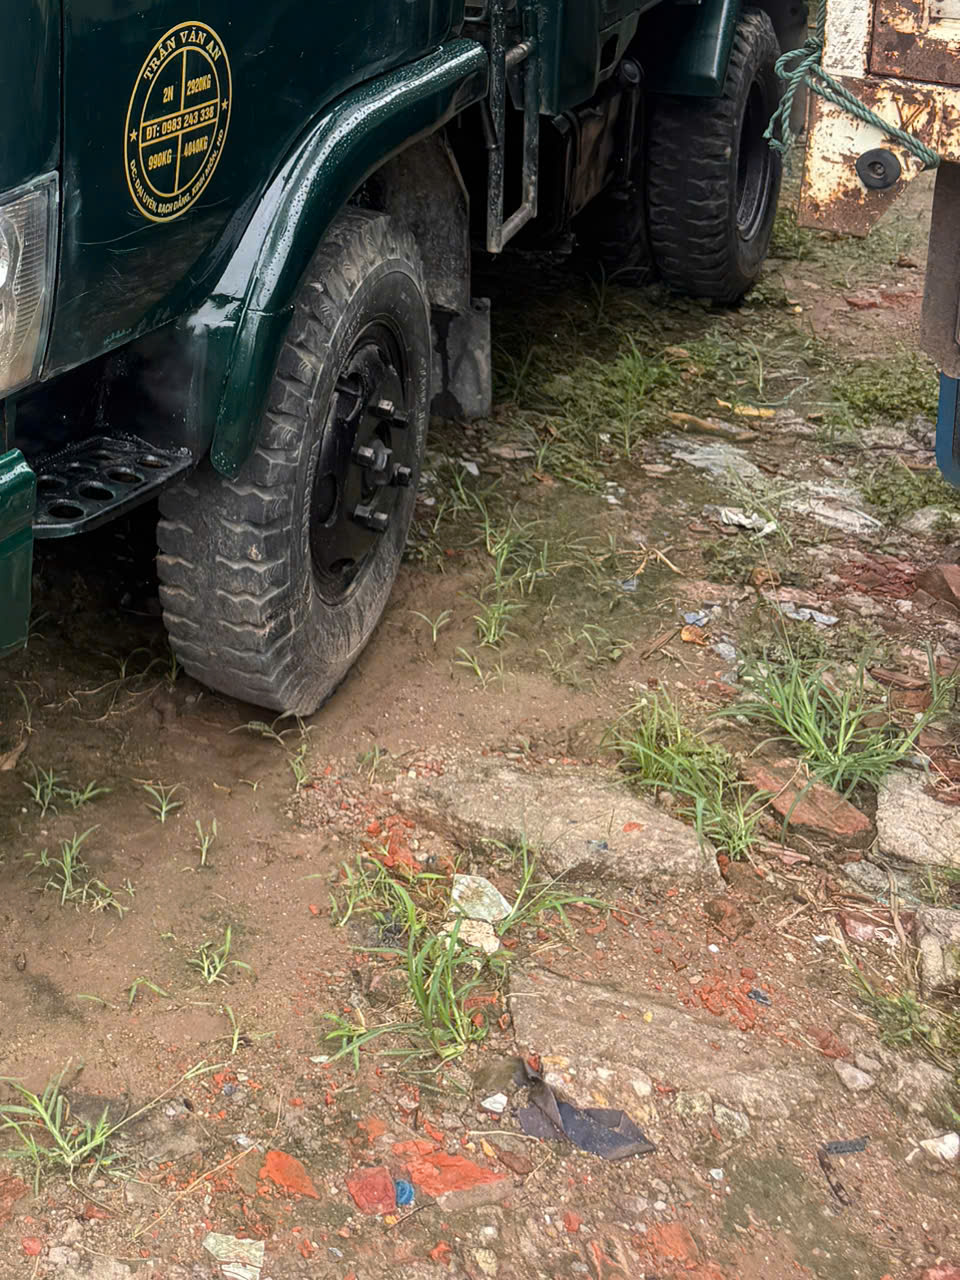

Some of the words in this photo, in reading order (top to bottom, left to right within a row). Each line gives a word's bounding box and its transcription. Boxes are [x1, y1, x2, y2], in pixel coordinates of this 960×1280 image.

[180, 27, 206, 46] VĂN
[206, 40, 222, 63] AN
[163, 85, 174, 104] 2N
[161, 118, 182, 136] 0983
[183, 111, 199, 129] 243
[148, 149, 172, 171] 990KG
